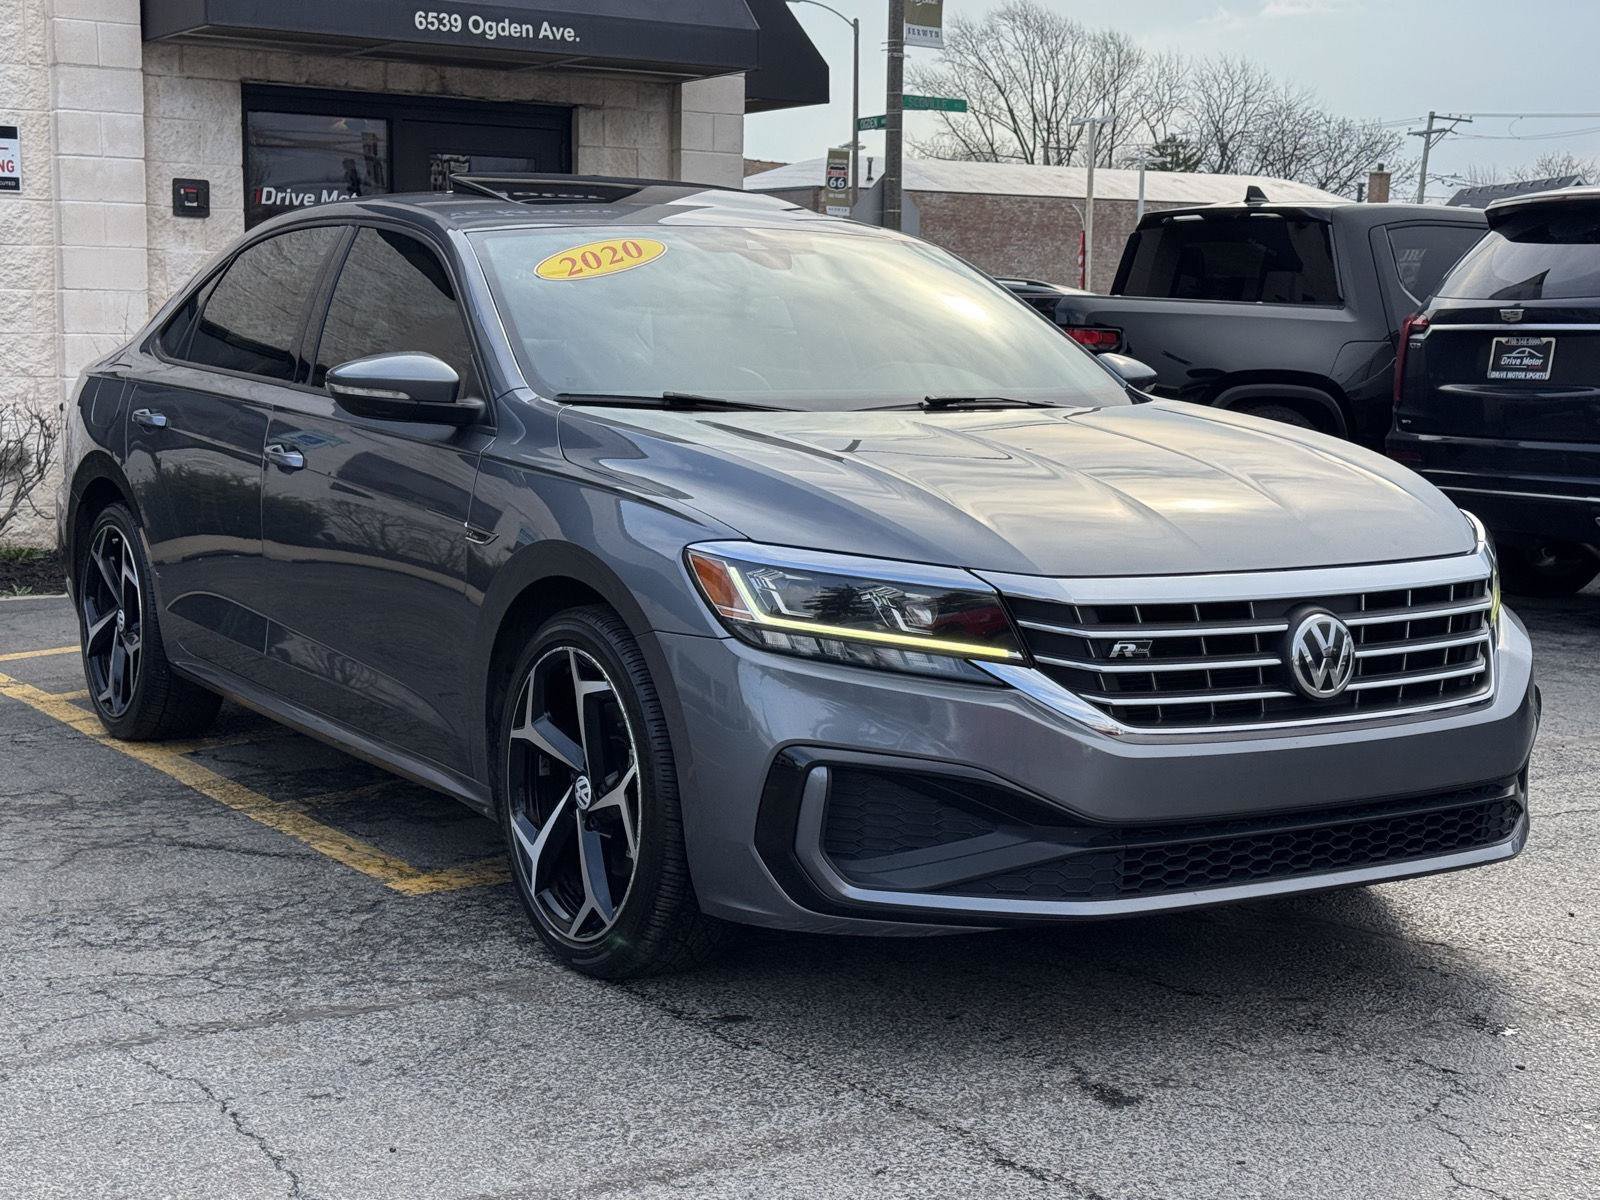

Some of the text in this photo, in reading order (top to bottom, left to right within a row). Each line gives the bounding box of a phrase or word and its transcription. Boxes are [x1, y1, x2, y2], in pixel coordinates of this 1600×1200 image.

[414, 11, 581, 42] 6539 Ogden Ave.
[830, 177, 845, 188] 66
[559, 240, 643, 276] 2020
[1522, 356, 1544, 366] Motor
[1293, 614, 1354, 698] VW
